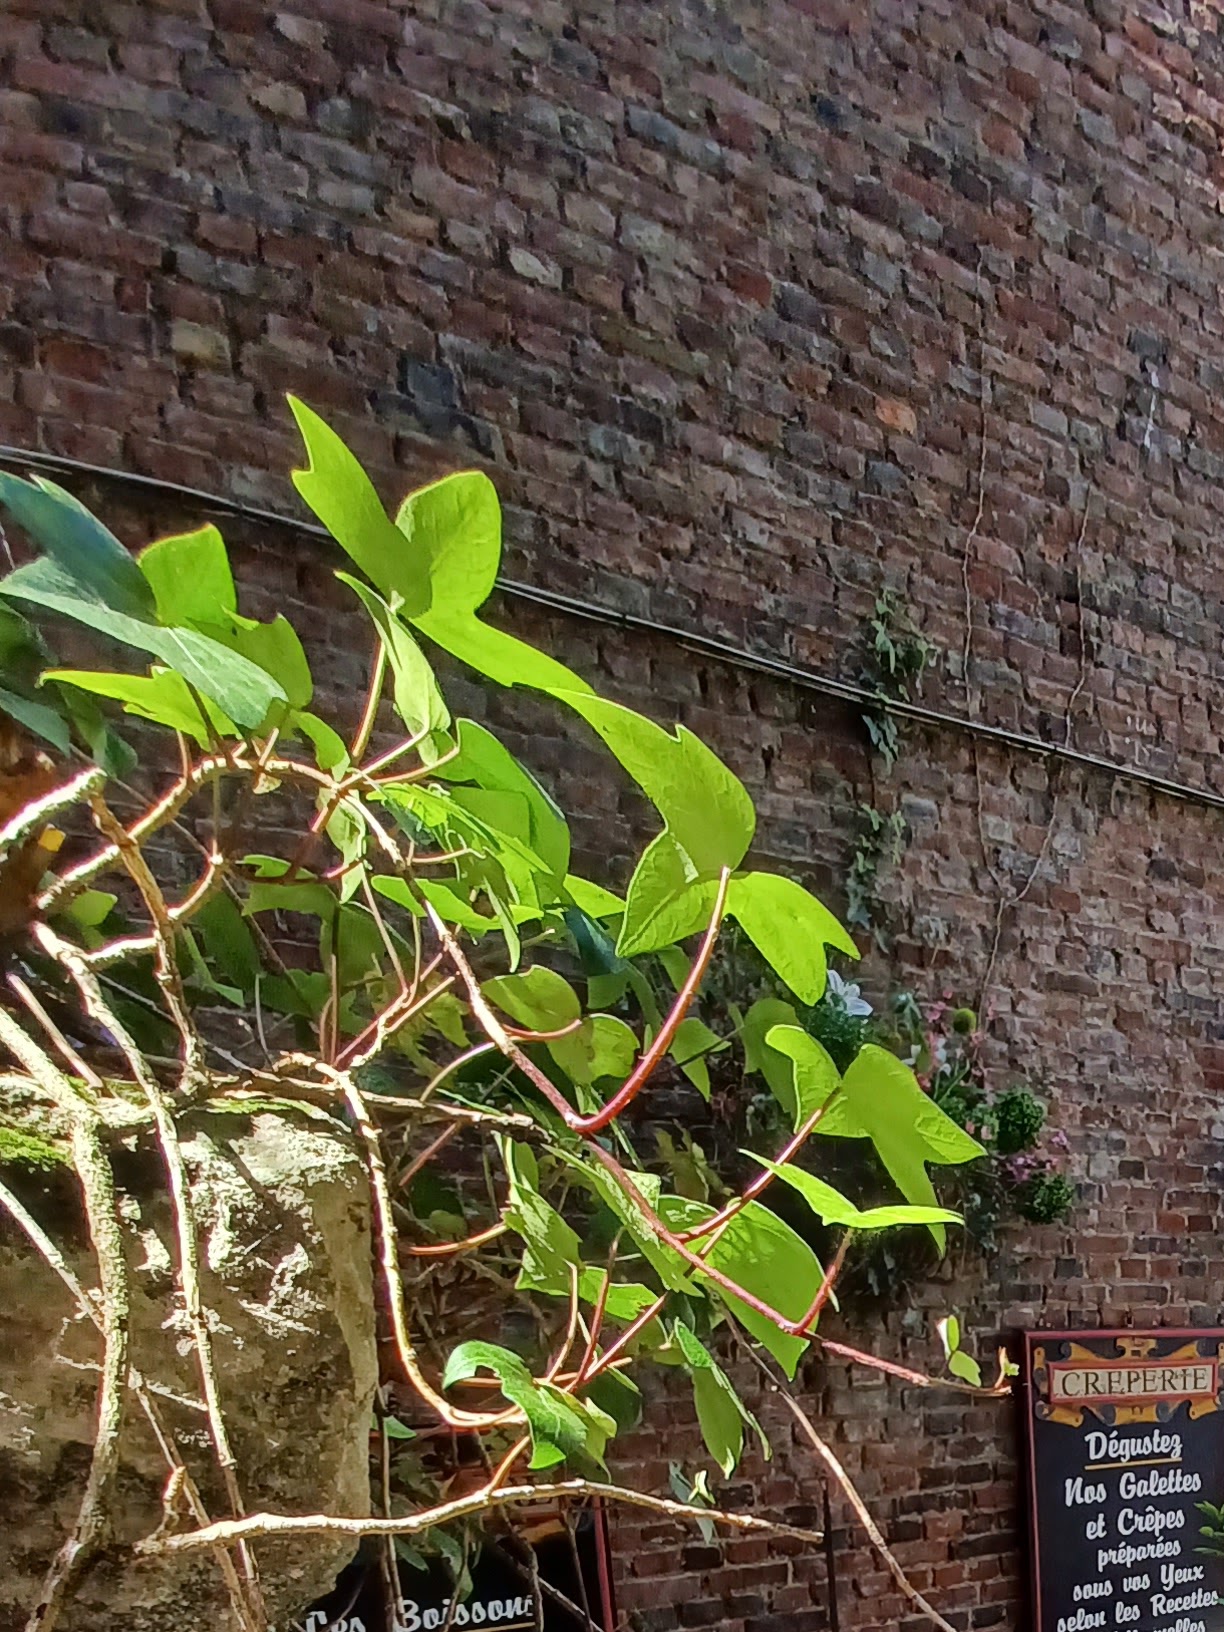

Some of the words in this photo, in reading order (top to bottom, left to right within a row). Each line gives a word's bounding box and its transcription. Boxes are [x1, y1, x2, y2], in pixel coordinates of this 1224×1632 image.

[1062, 1367, 1209, 1397] CREPERIE
[1084, 1428, 1183, 1463] Dégustez
[1065, 1477, 1107, 1507] Nos
[1119, 1468, 1202, 1500] Galettes
[1086, 1513, 1107, 1540] et
[1117, 1505, 1186, 1537] Crêpes
[1097, 1536, 1182, 1573] préparées
[1073, 1579, 1113, 1602] sous
[1122, 1573, 1151, 1593] vos
[1160, 1563, 1205, 1592] Yeux
[1115, 1601, 1141, 1624] les
[1149, 1588, 1219, 1617] Recettes
